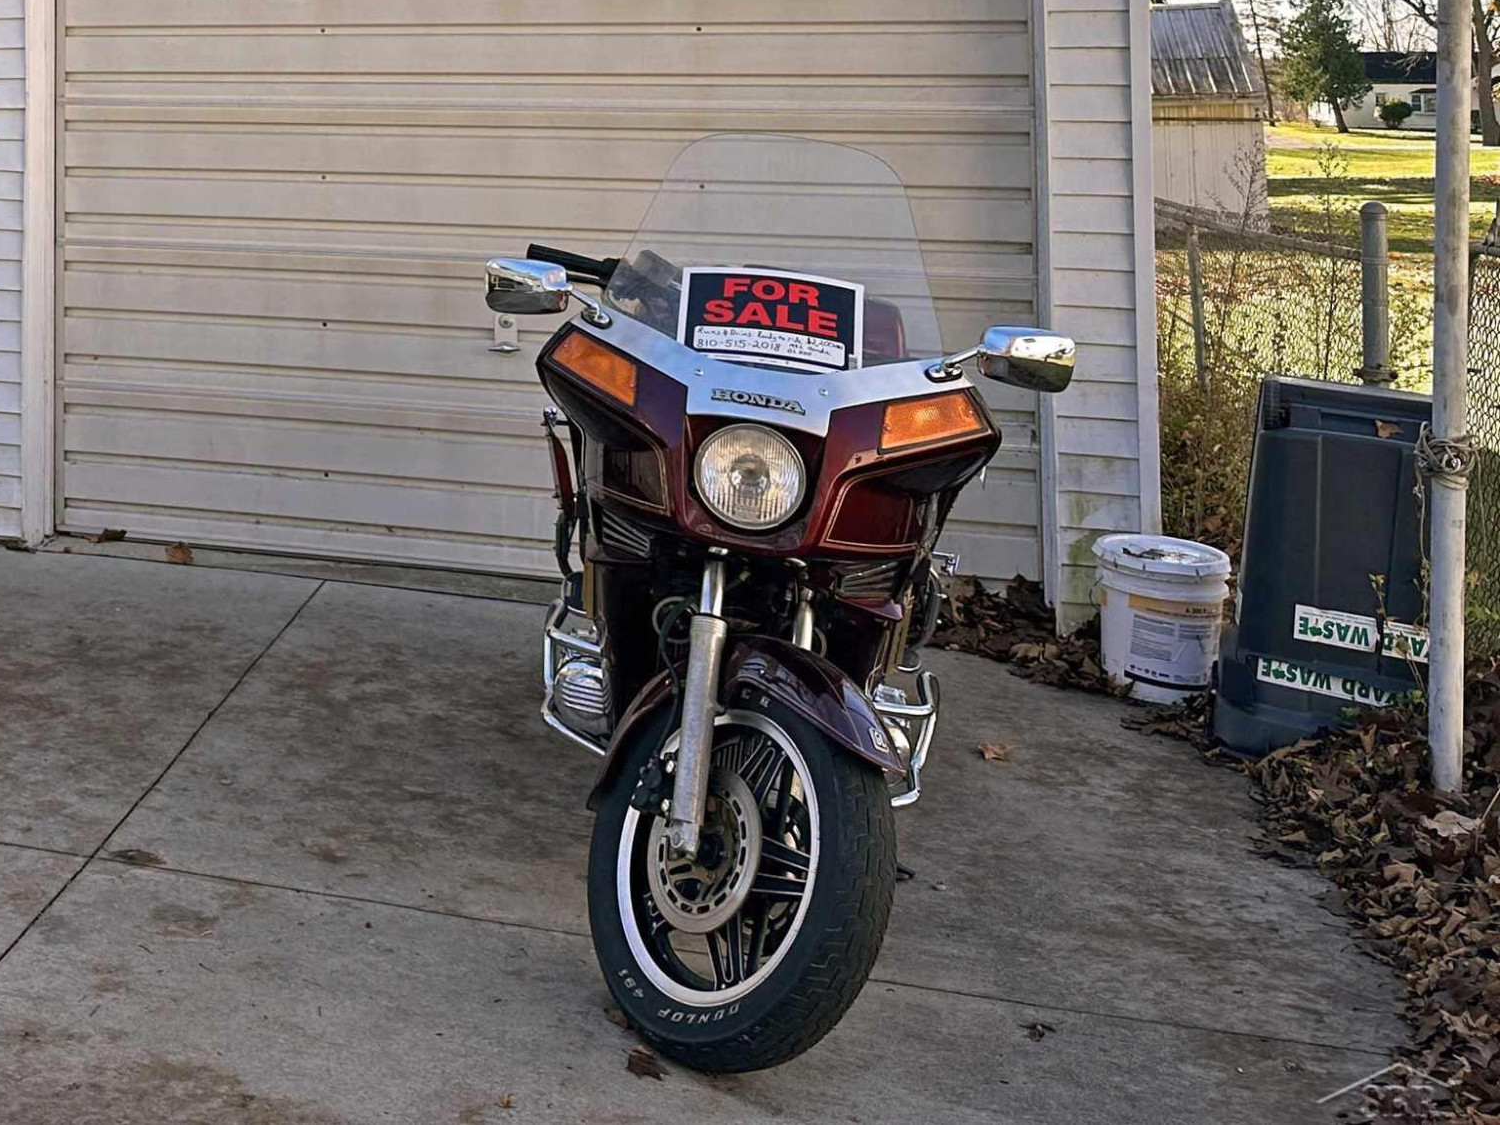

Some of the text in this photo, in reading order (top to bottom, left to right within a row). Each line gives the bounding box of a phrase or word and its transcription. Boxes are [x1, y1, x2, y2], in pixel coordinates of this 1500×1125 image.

[723, 278, 819, 307] FOR
[703, 299, 838, 337] SALE
[696, 338, 782, 352] 810-515-2018
[711, 388, 806, 416] HONDA
[657, 1003, 740, 1025] DUNLOP
